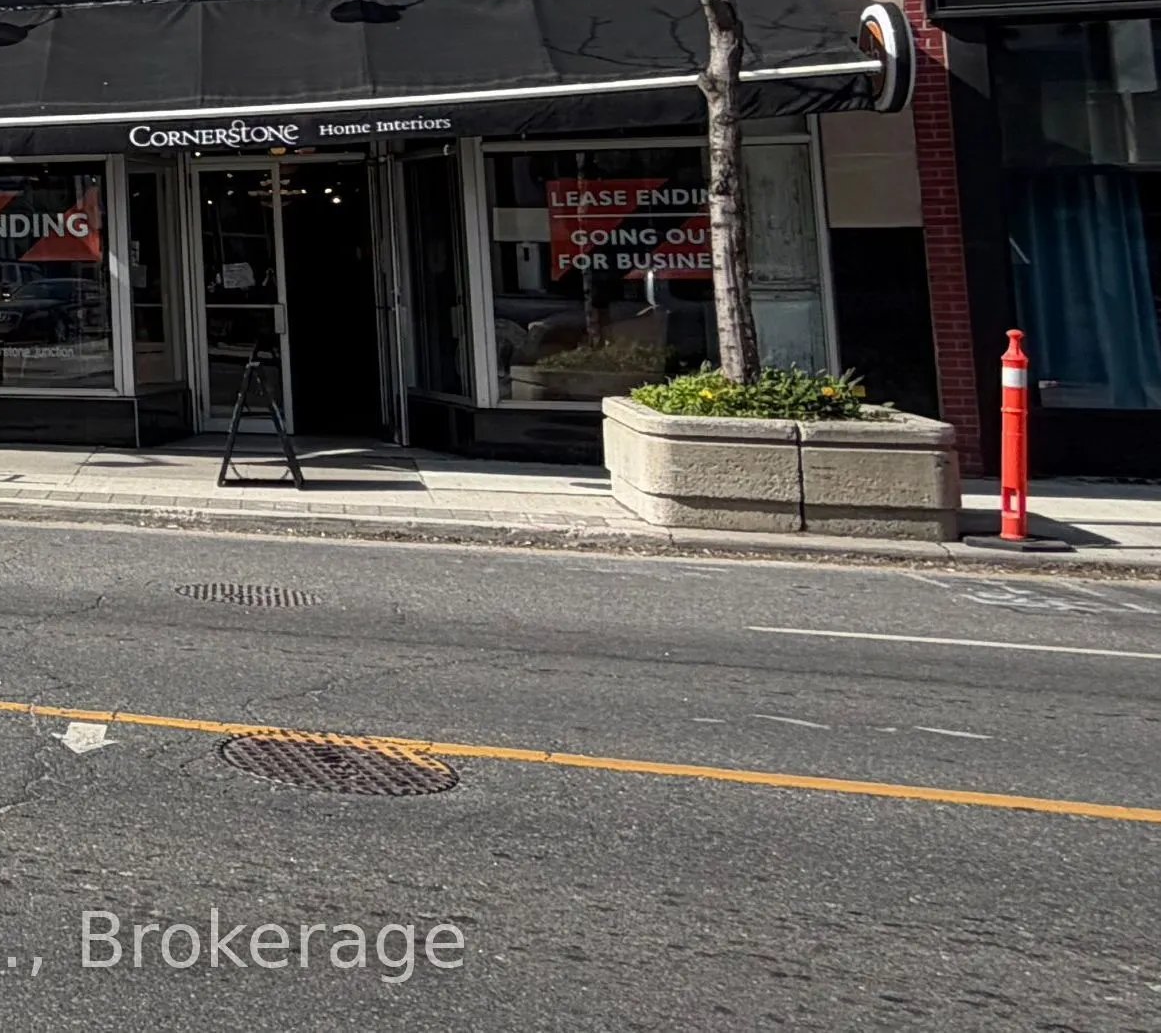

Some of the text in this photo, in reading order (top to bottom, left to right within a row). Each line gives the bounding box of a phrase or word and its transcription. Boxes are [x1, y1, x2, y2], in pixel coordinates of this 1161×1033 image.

[319, 122, 371, 136] Home
[376, 115, 452, 133] Interiors
[551, 188, 712, 207] LEASE ENDIN
[571, 227, 712, 245] GOING OU
[558, 252, 713, 270] FOR BUSINE
